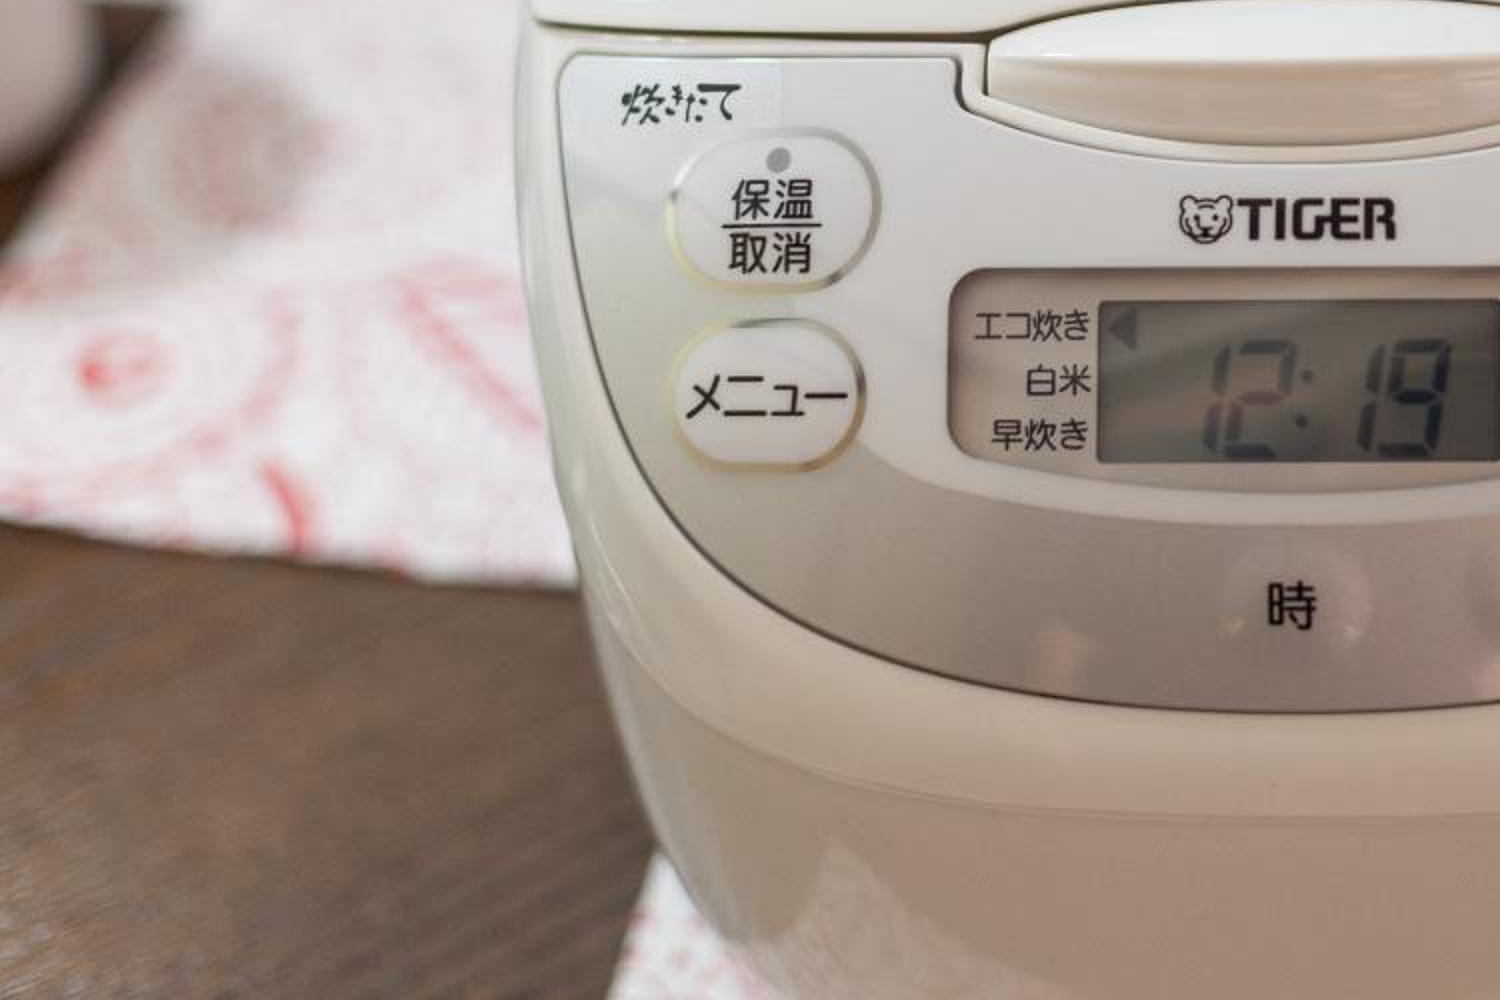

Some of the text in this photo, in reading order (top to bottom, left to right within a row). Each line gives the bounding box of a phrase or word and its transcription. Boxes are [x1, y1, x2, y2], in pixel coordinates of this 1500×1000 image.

[621, 83, 742, 126] 炊きたて
[731, 179, 814, 221] 保温
[1237, 197, 1397, 241] TIGER
[728, 231, 812, 275] 取消
[975, 309, 1089, 342] エコ炊き
[685, 374, 849, 420] メニュー
[1026, 363, 1092, 397] 白米
[1204, 338, 1452, 459] 12:19
[991, 417, 1089, 452] 早炊き
[1267, 580, 1318, 631] 時
